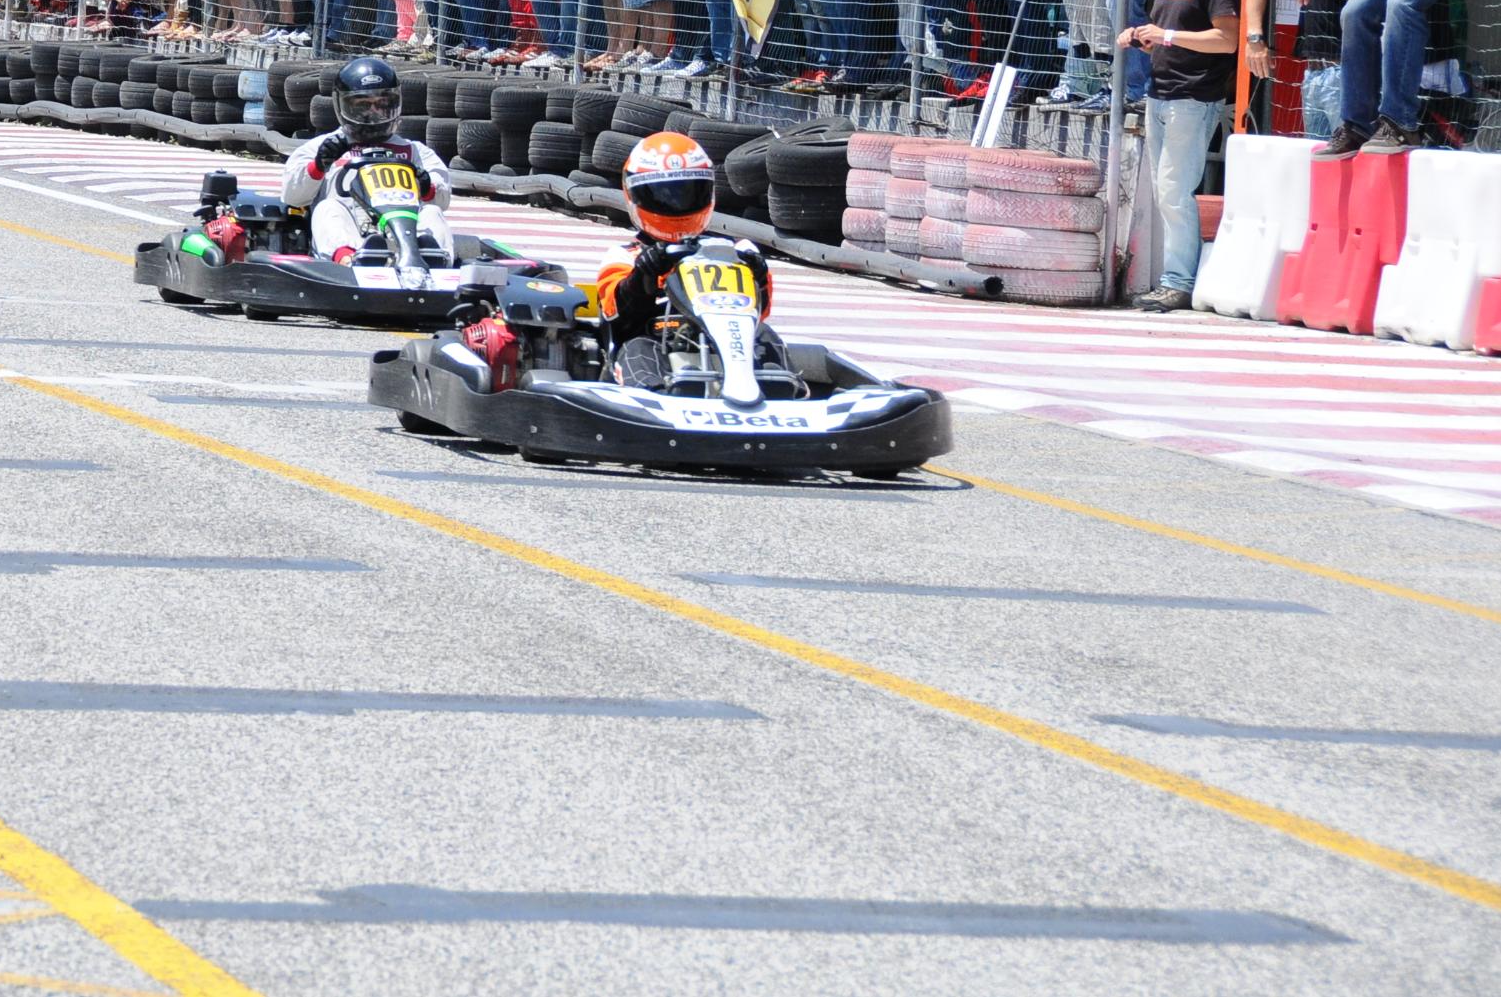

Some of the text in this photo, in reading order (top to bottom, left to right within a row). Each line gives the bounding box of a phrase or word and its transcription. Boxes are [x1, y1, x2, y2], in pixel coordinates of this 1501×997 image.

[367, 167, 413, 190] 100
[687, 264, 745, 294] 127
[727, 320, 745, 352] Beta
[715, 412, 809, 428] Beta
